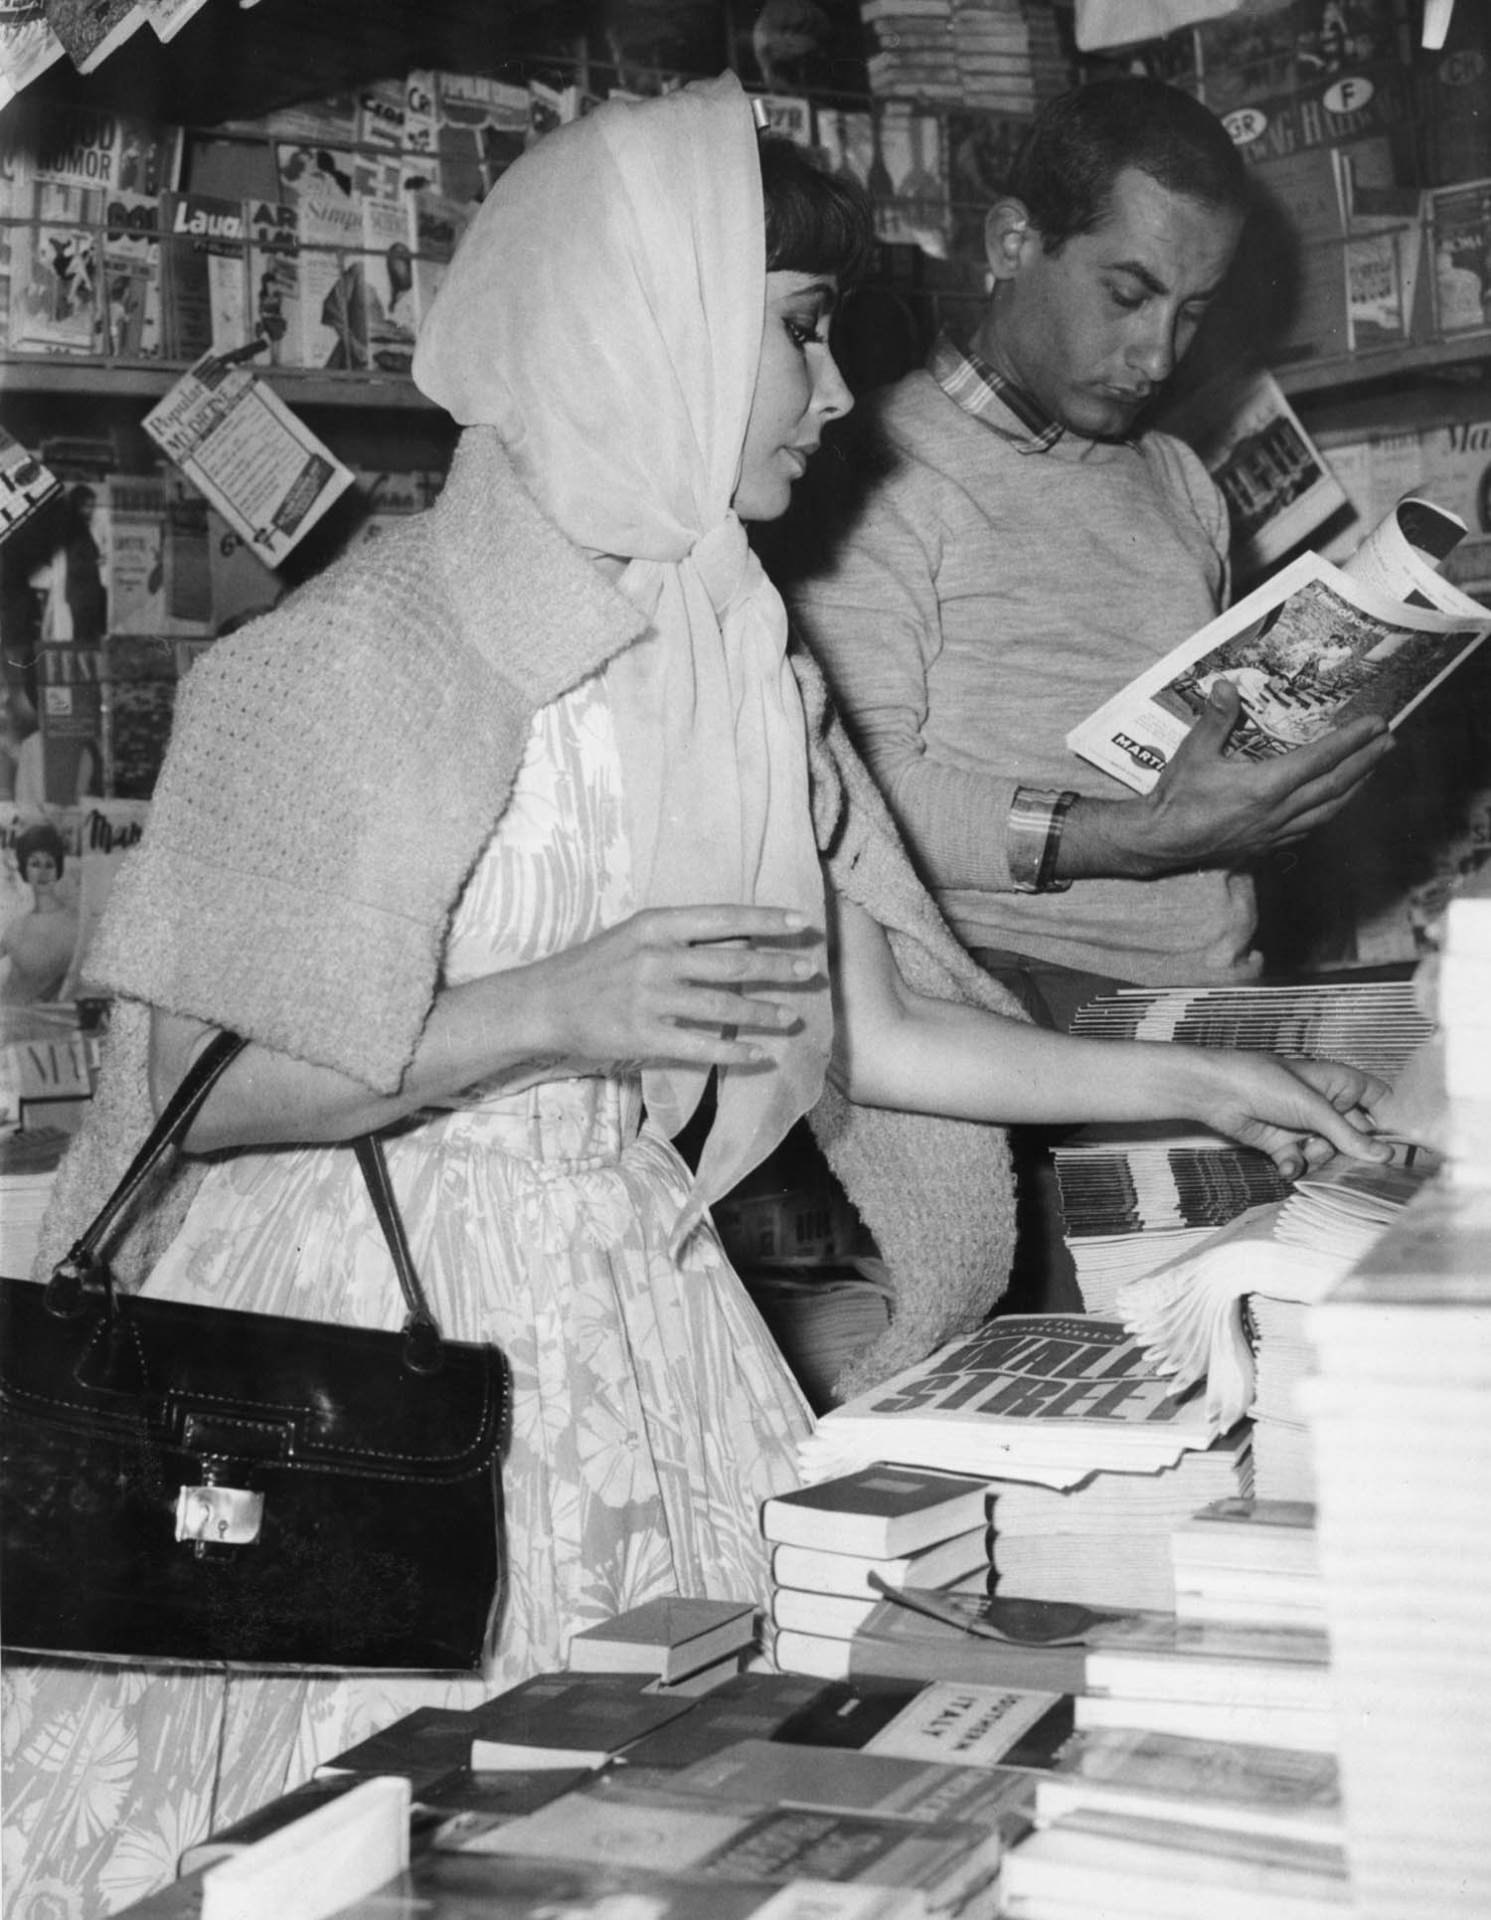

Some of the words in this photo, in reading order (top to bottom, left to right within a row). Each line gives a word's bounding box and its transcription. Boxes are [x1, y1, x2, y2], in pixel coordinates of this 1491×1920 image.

[1341, 81, 1355, 108] F
[1225, 114, 1256, 139] GR
[149, 383, 204, 437] Popular
[927, 1337, 1178, 1379] WALL
[870, 1373, 1207, 1421] STREET
[921, 1696, 979, 1736] ITALY
